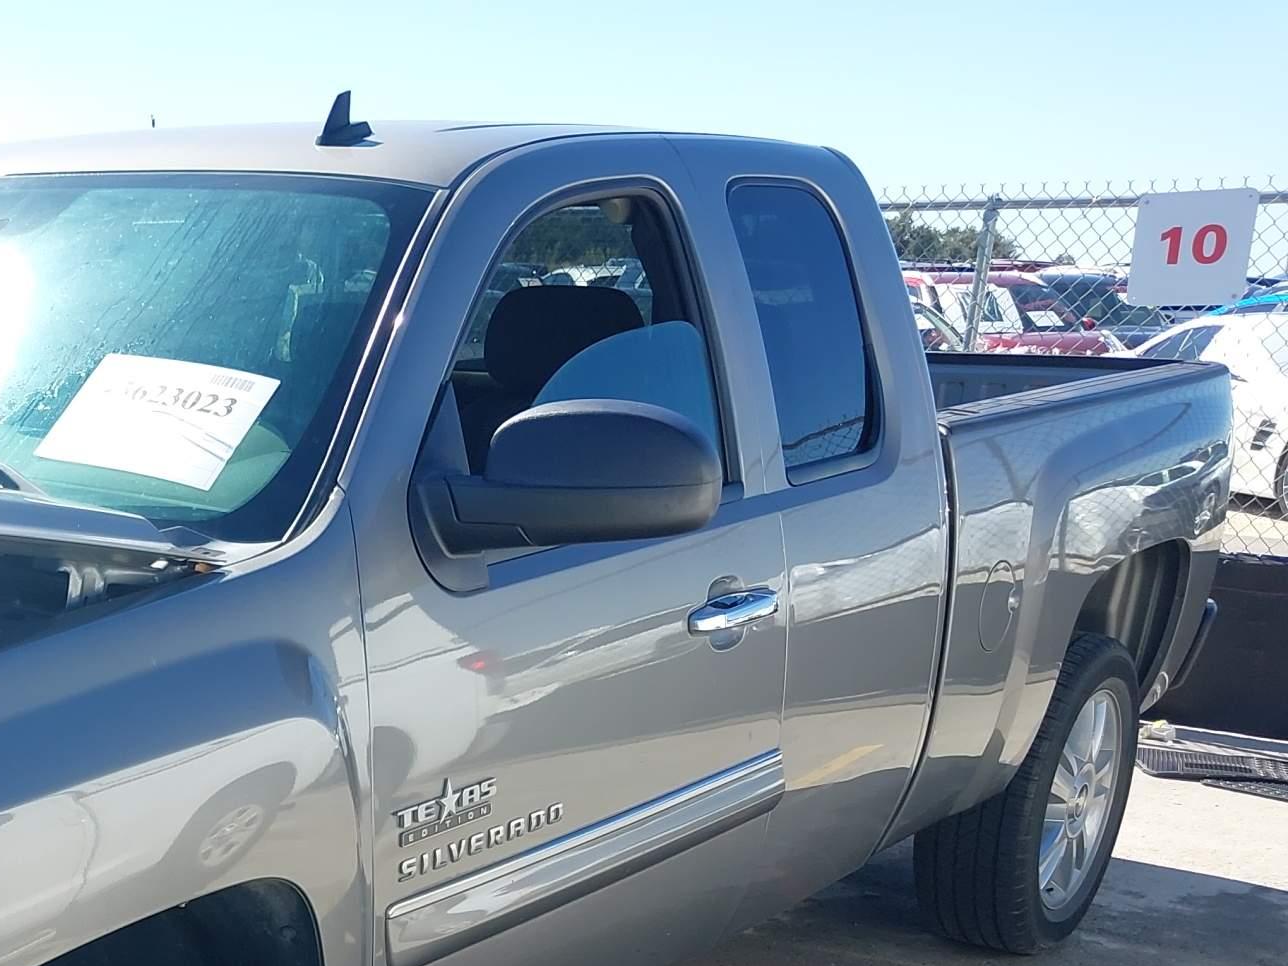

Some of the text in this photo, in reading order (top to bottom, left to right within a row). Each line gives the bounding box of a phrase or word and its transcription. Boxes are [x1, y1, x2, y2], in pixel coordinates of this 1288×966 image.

[1160, 224, 1228, 265] 10
[103, 375, 238, 417] 623023
[390, 777, 497, 829] TEXAS
[408, 805, 487, 842] EDITION
[398, 801, 564, 883] SILVERADO
